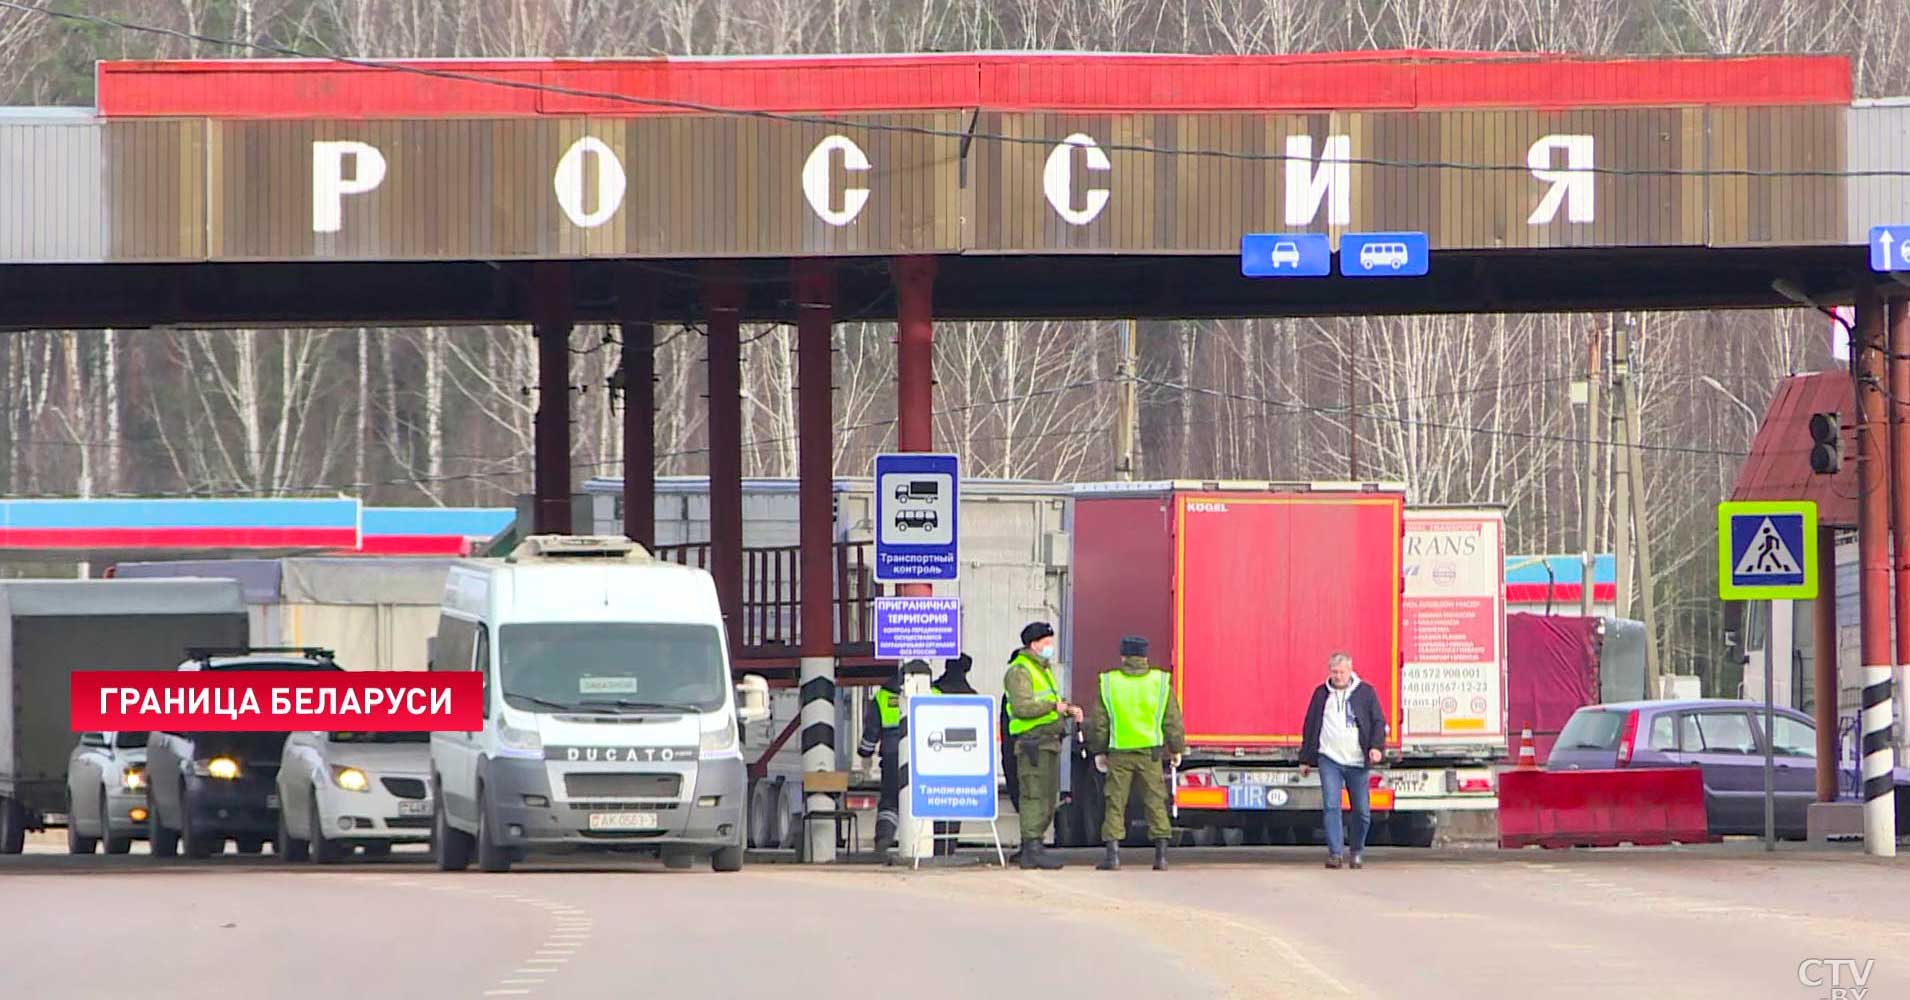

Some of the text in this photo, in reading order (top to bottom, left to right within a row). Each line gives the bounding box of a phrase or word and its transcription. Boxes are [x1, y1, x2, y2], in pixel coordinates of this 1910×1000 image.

[313, 133, 1595, 232] РОССИЯ
[880, 552, 954, 564] Транспортный
[893, 565, 942, 575] контроль
[878, 600, 957, 610] ПРИГРАНИЧНАЯ
[887, 614, 948, 624] ТЕРРИТОРИЯ
[567, 748, 674, 761] DUCATO
[919, 784, 988, 796] Таможенный
[1230, 786, 1263, 806] TIR
[927, 796, 978, 808] контроль
